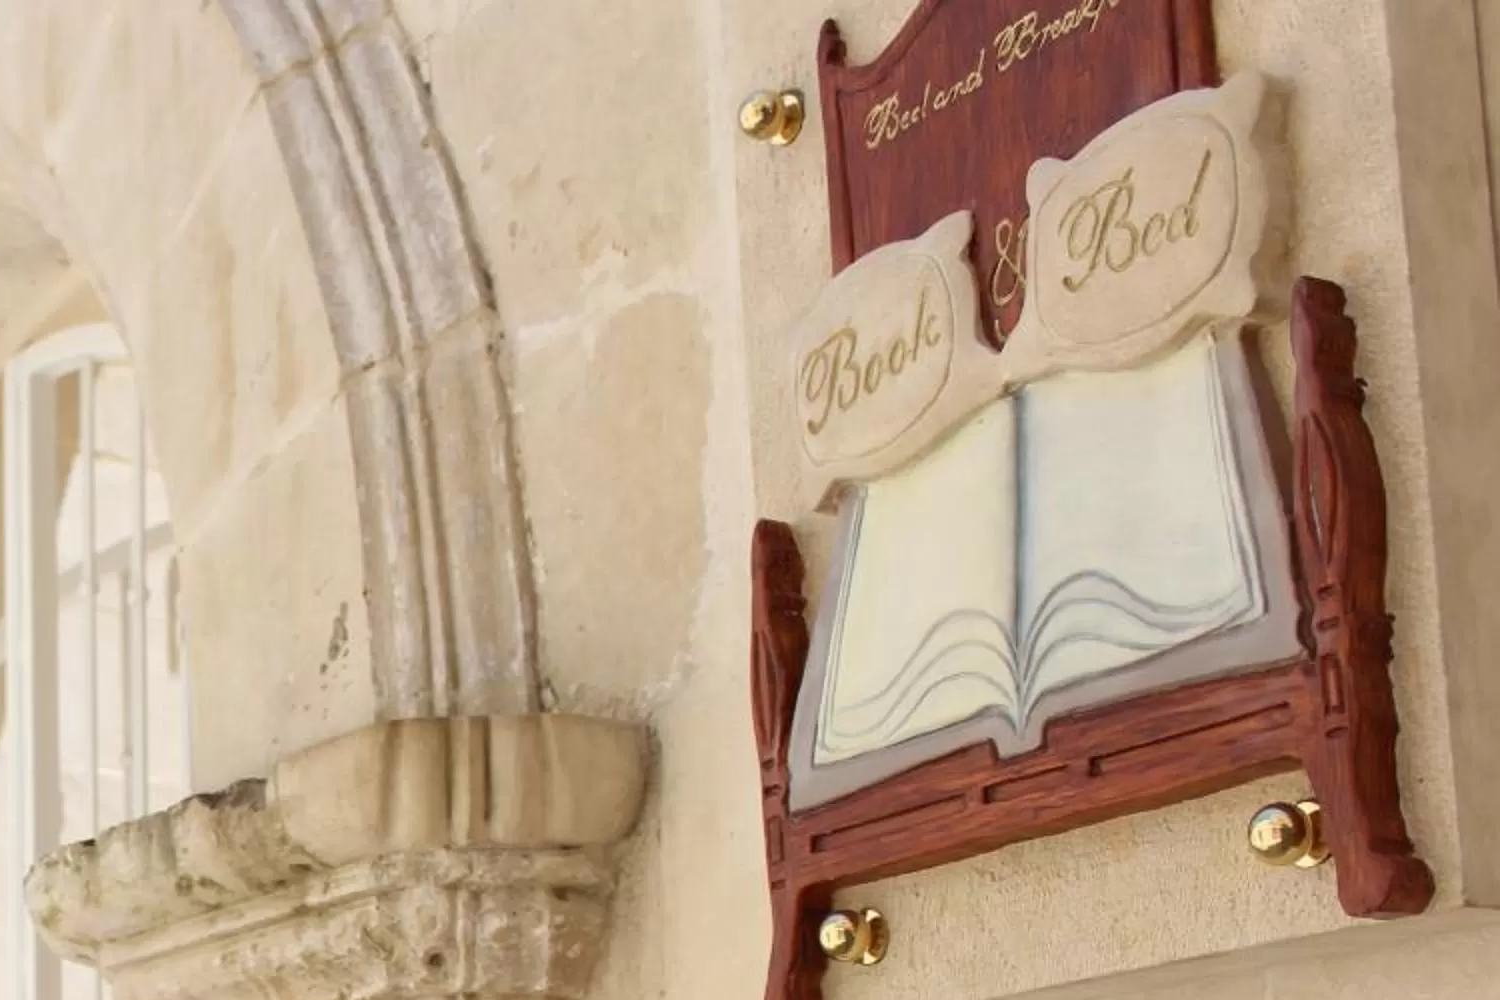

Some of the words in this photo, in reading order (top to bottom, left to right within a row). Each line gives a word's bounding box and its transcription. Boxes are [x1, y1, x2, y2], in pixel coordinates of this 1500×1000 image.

[863, 90, 931, 150] Bed
[932, 47, 985, 110] and
[800, 287, 941, 436] Book
[992, 218, 1028, 307] &
[1057, 147, 1211, 293] Bed
